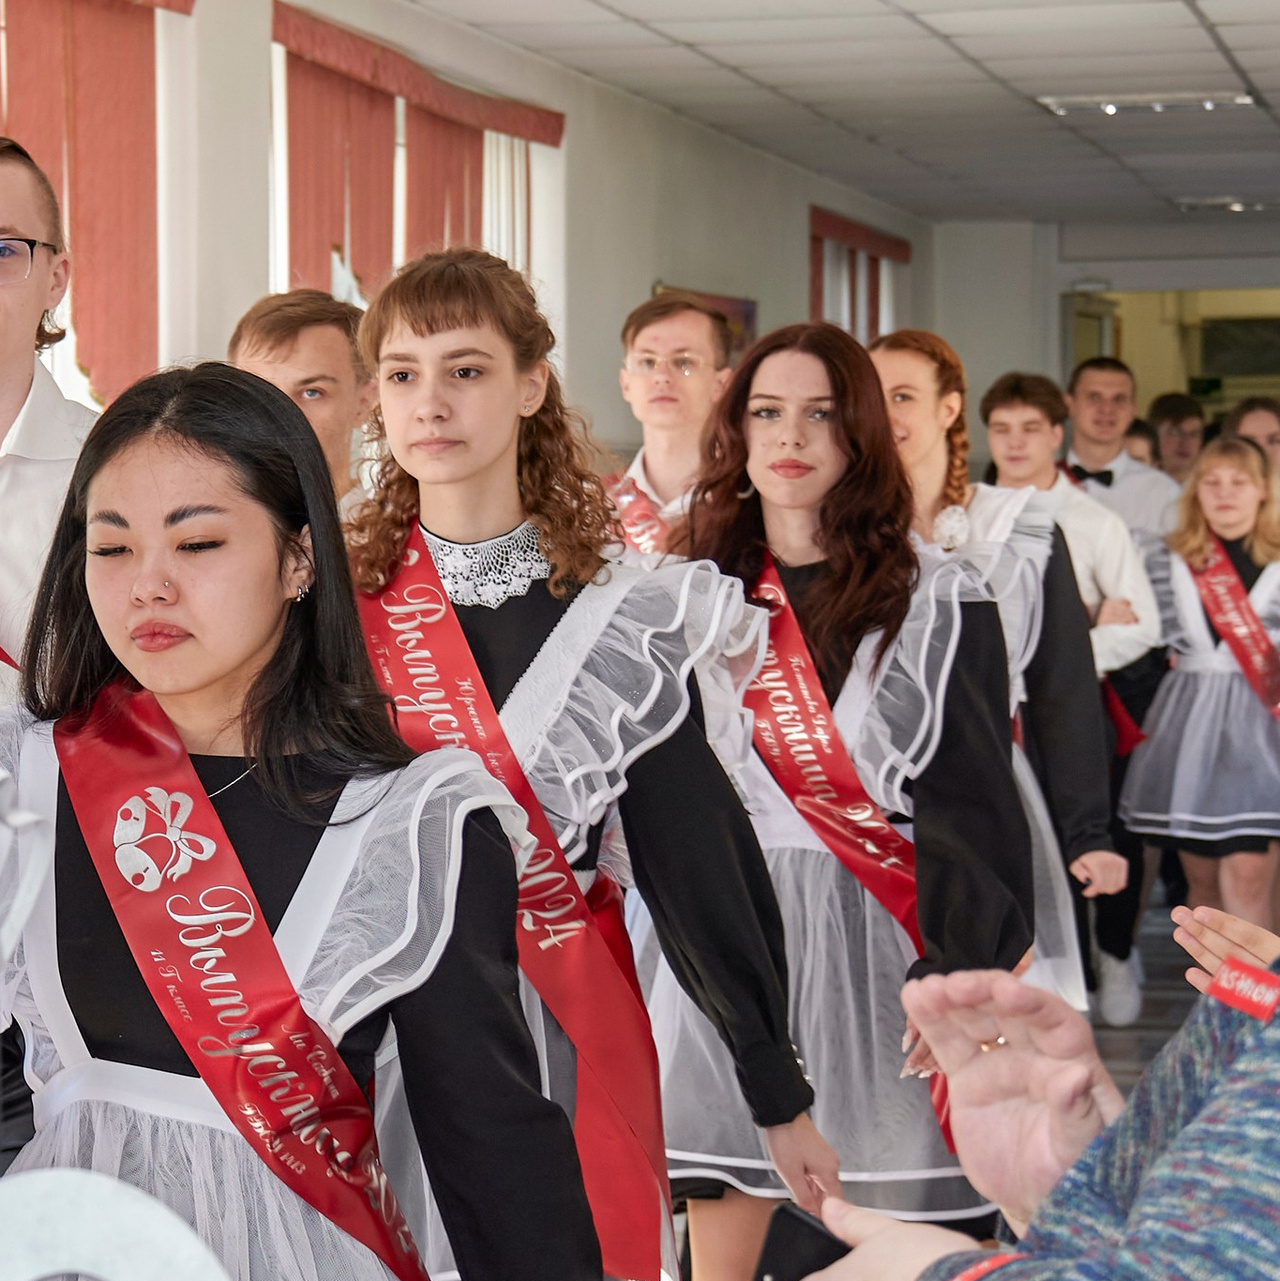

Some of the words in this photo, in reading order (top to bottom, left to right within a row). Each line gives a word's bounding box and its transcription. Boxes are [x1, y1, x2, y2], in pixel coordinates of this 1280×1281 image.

[380, 584, 470, 751] Выпуск
[454, 676, 487, 740] Юрченко
[150, 948, 166, 962] 11
[159, 965, 183, 983] Г
[166, 985, 193, 1023] класс
[281, 1024, 309, 1050] Ли
[307, 1044, 340, 1100] Сабина
